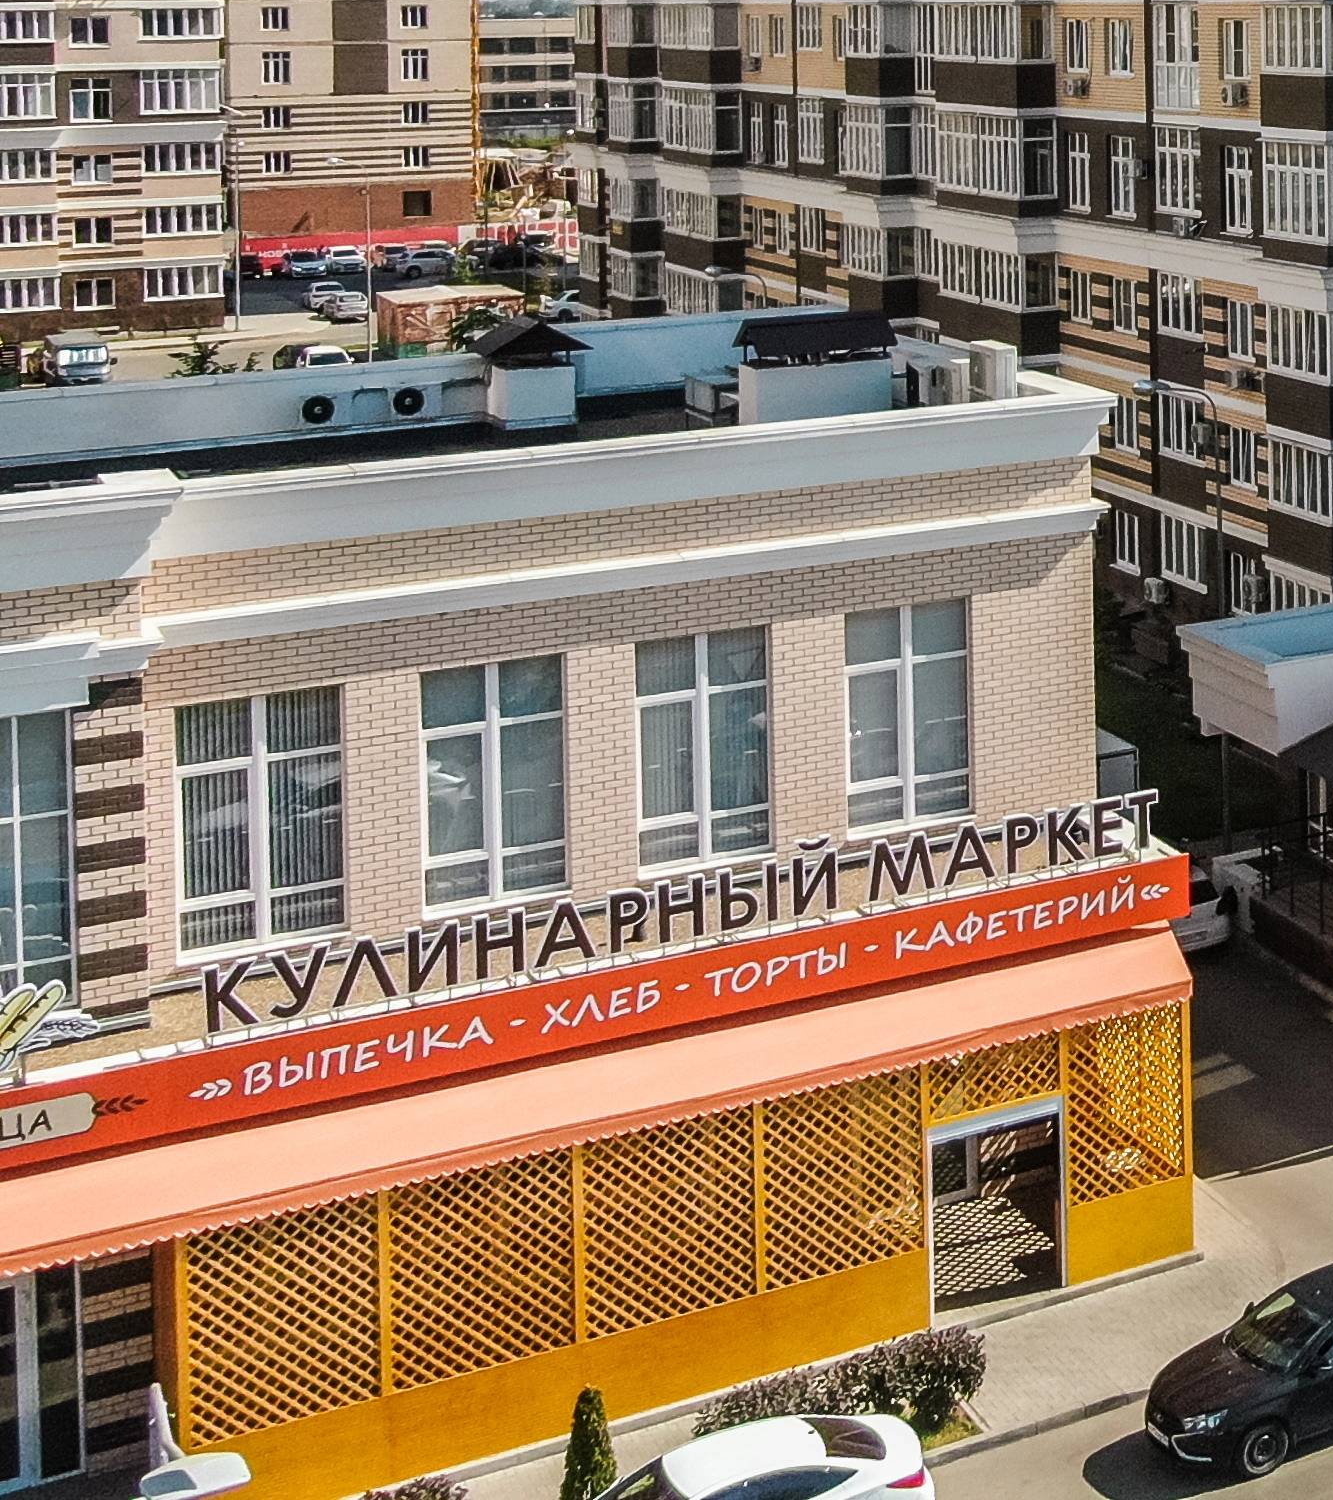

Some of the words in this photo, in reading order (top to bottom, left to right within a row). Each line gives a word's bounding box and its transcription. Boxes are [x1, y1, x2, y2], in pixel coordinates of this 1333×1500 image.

[201, 834, 840, 1035] КУЛИНАРНЫЙ
[868, 788, 1159, 902] МАРКЕТ
[242, 1016, 493, 1096] ВЫПЕЧКА
[541, 979, 662, 1035] ХЛЕБ
[704, 941, 847, 997] ТОРТЫ
[893, 873, 1136, 960] КАФЕТЕРИЙ
